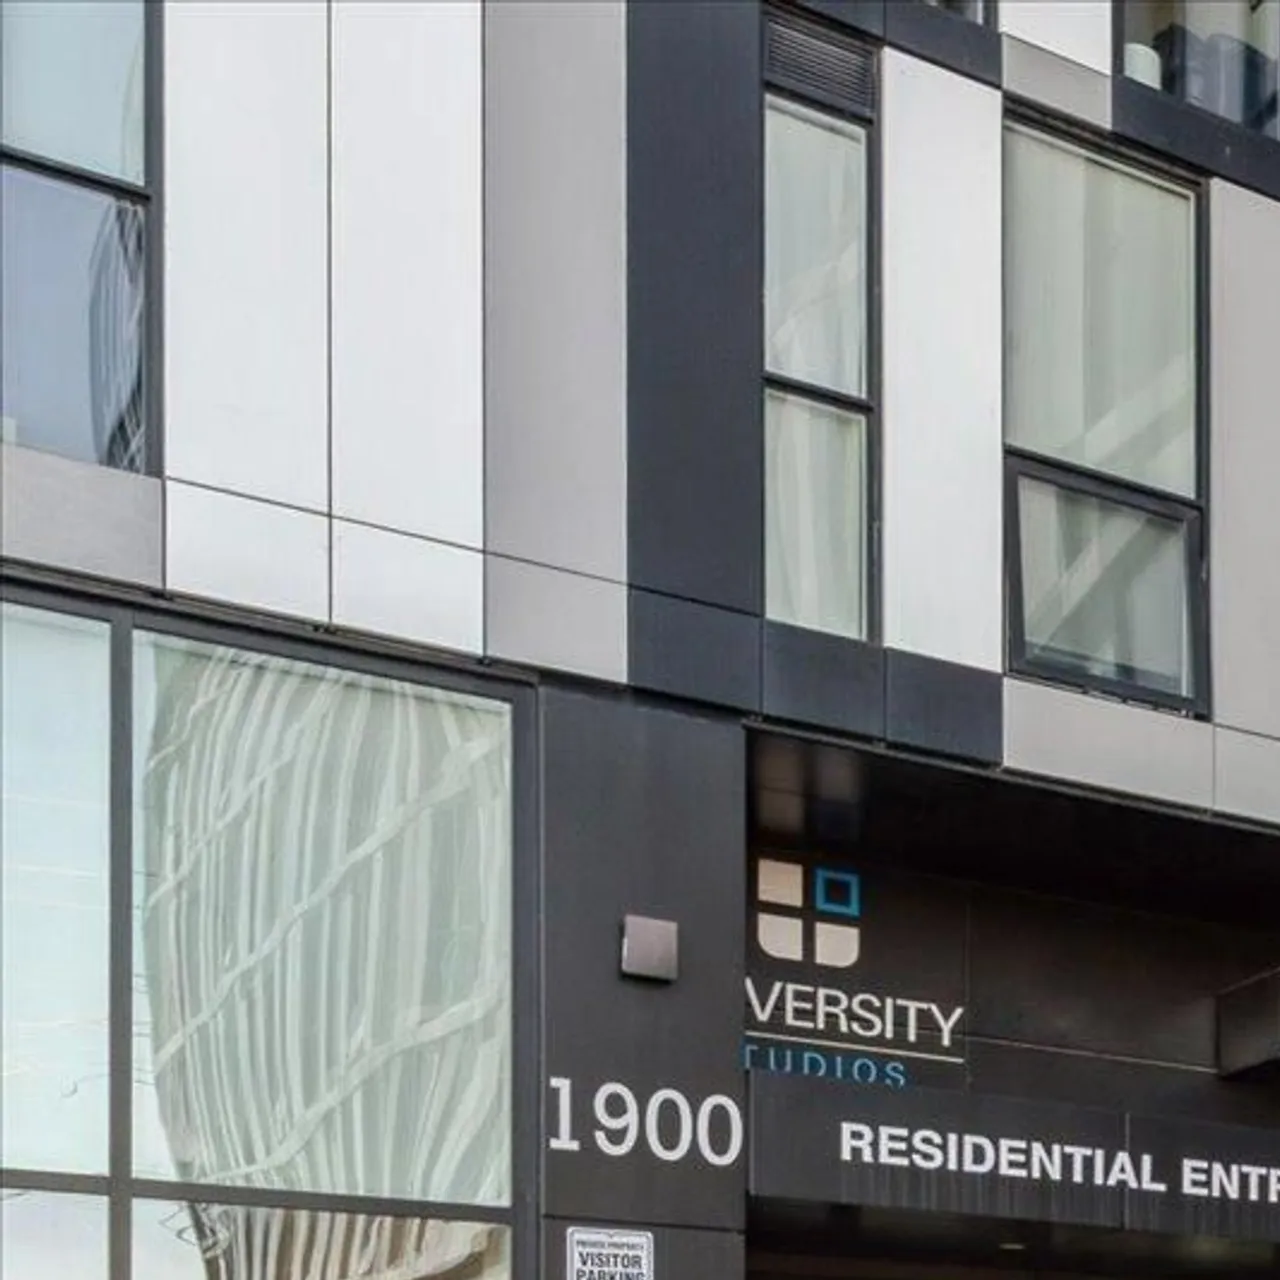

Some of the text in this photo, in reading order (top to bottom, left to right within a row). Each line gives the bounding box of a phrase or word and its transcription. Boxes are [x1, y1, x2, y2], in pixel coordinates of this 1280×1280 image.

[548, 1076, 743, 1167] 1900
[839, 1120, 1167, 1193] RESIDENTIAL
[578, 1251, 643, 1269] VISITOR
